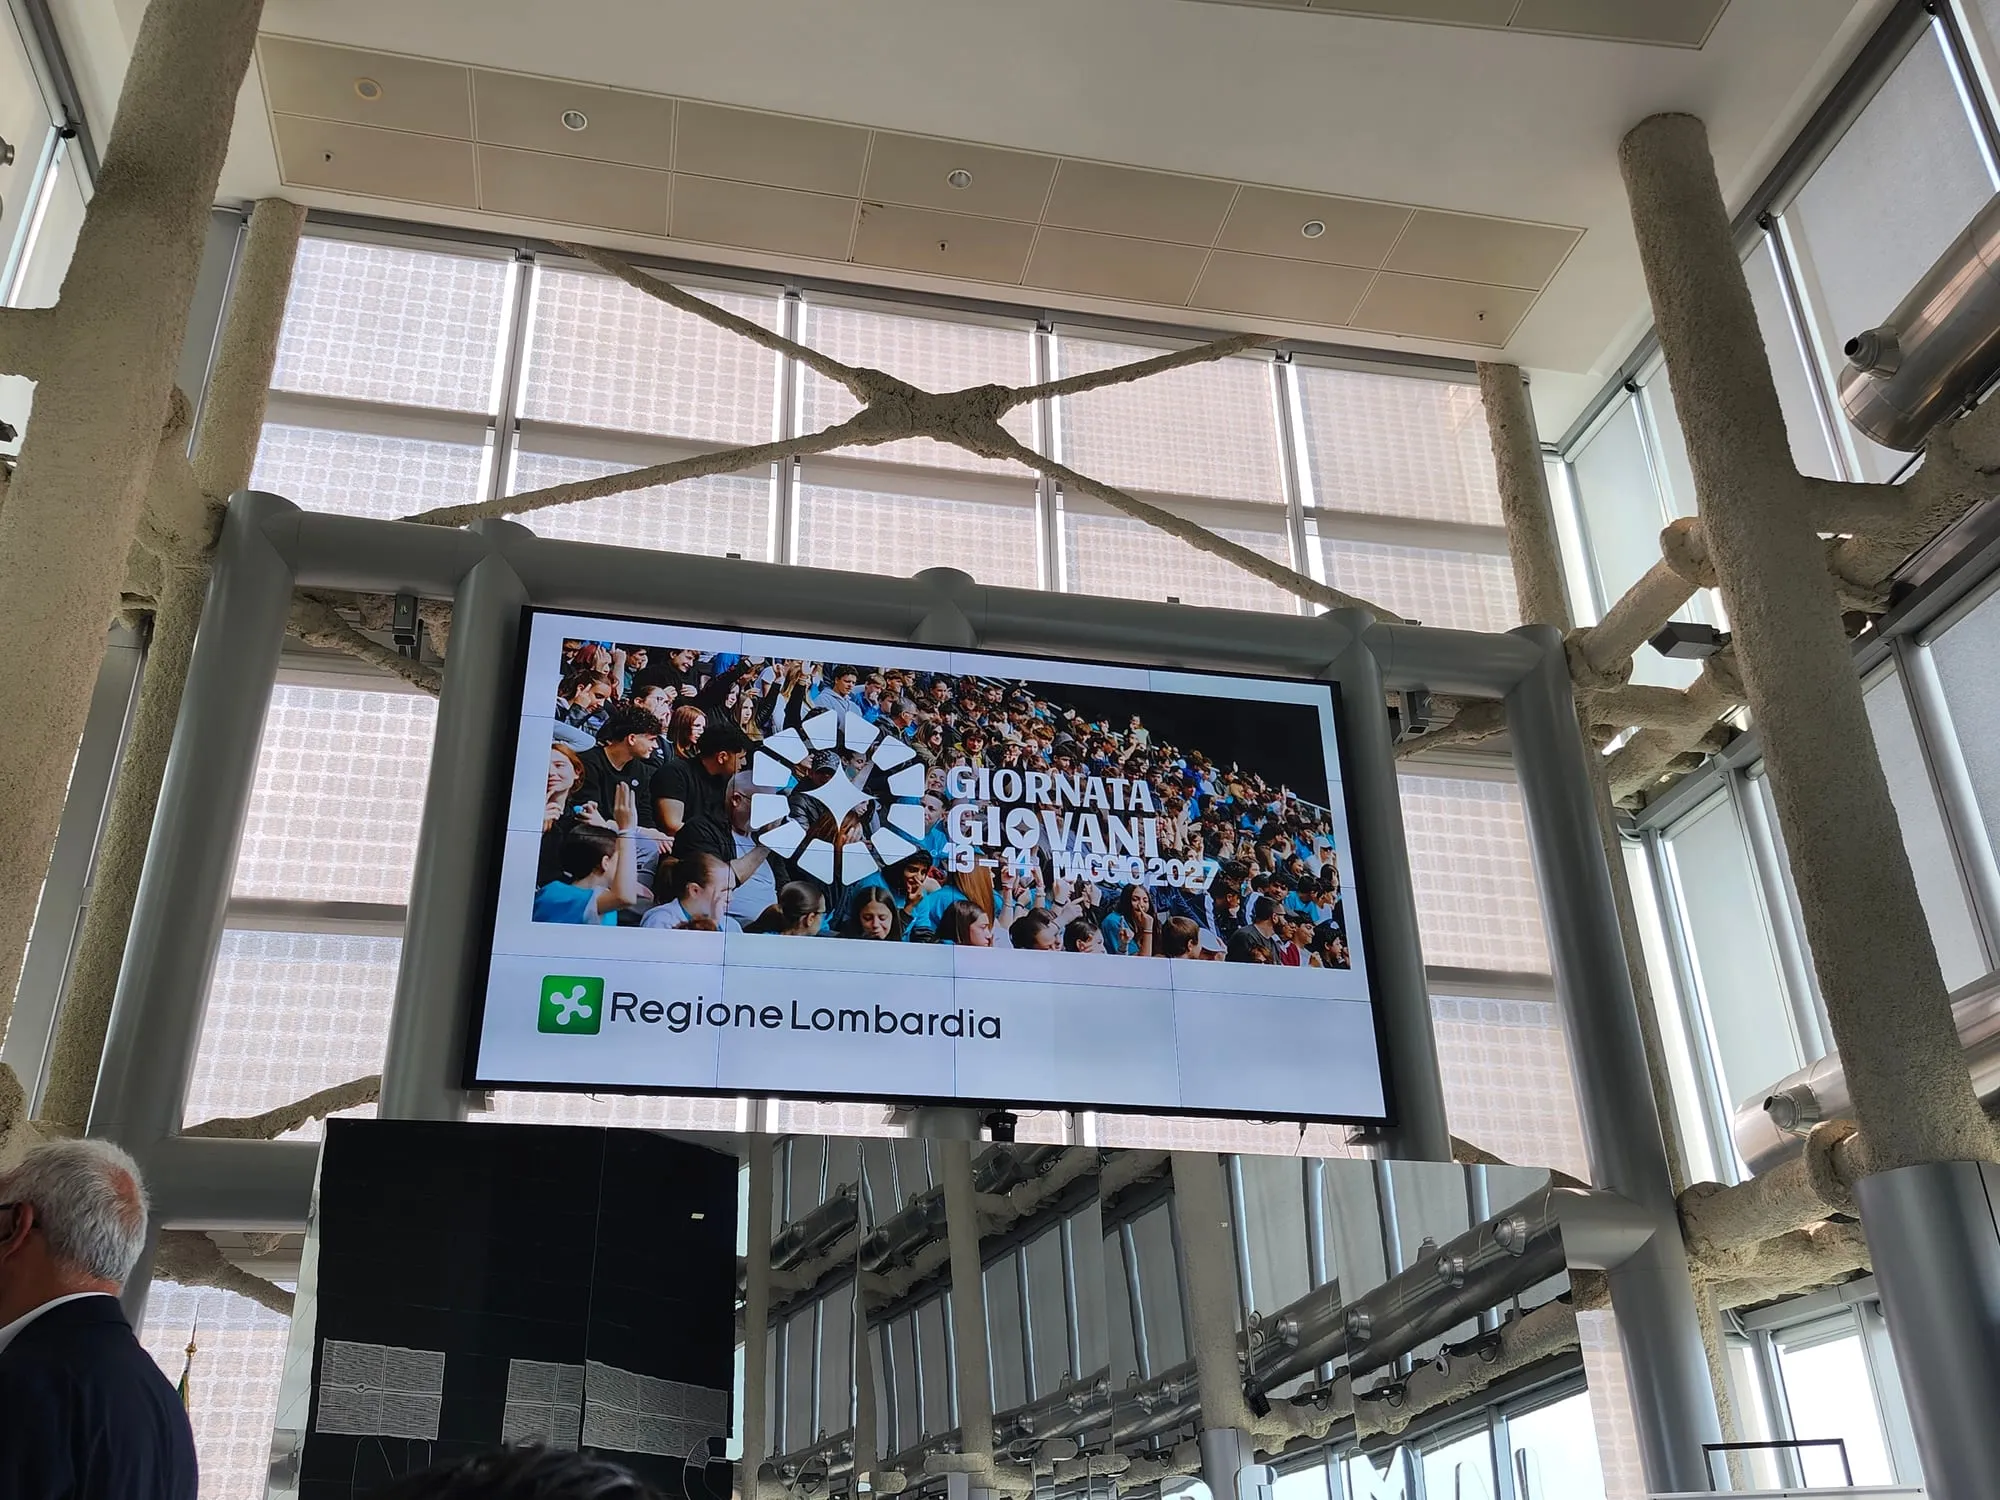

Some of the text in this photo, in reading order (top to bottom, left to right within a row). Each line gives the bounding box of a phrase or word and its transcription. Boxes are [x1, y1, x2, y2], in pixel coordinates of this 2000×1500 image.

[946, 766, 1156, 813] GIORNATA
[947, 804, 1158, 858] GIOVANI
[1052, 851, 1145, 885] MAGGIO
[1149, 858, 1220, 890] 2027
[610, 991, 1001, 1039] Regione Lombardia
